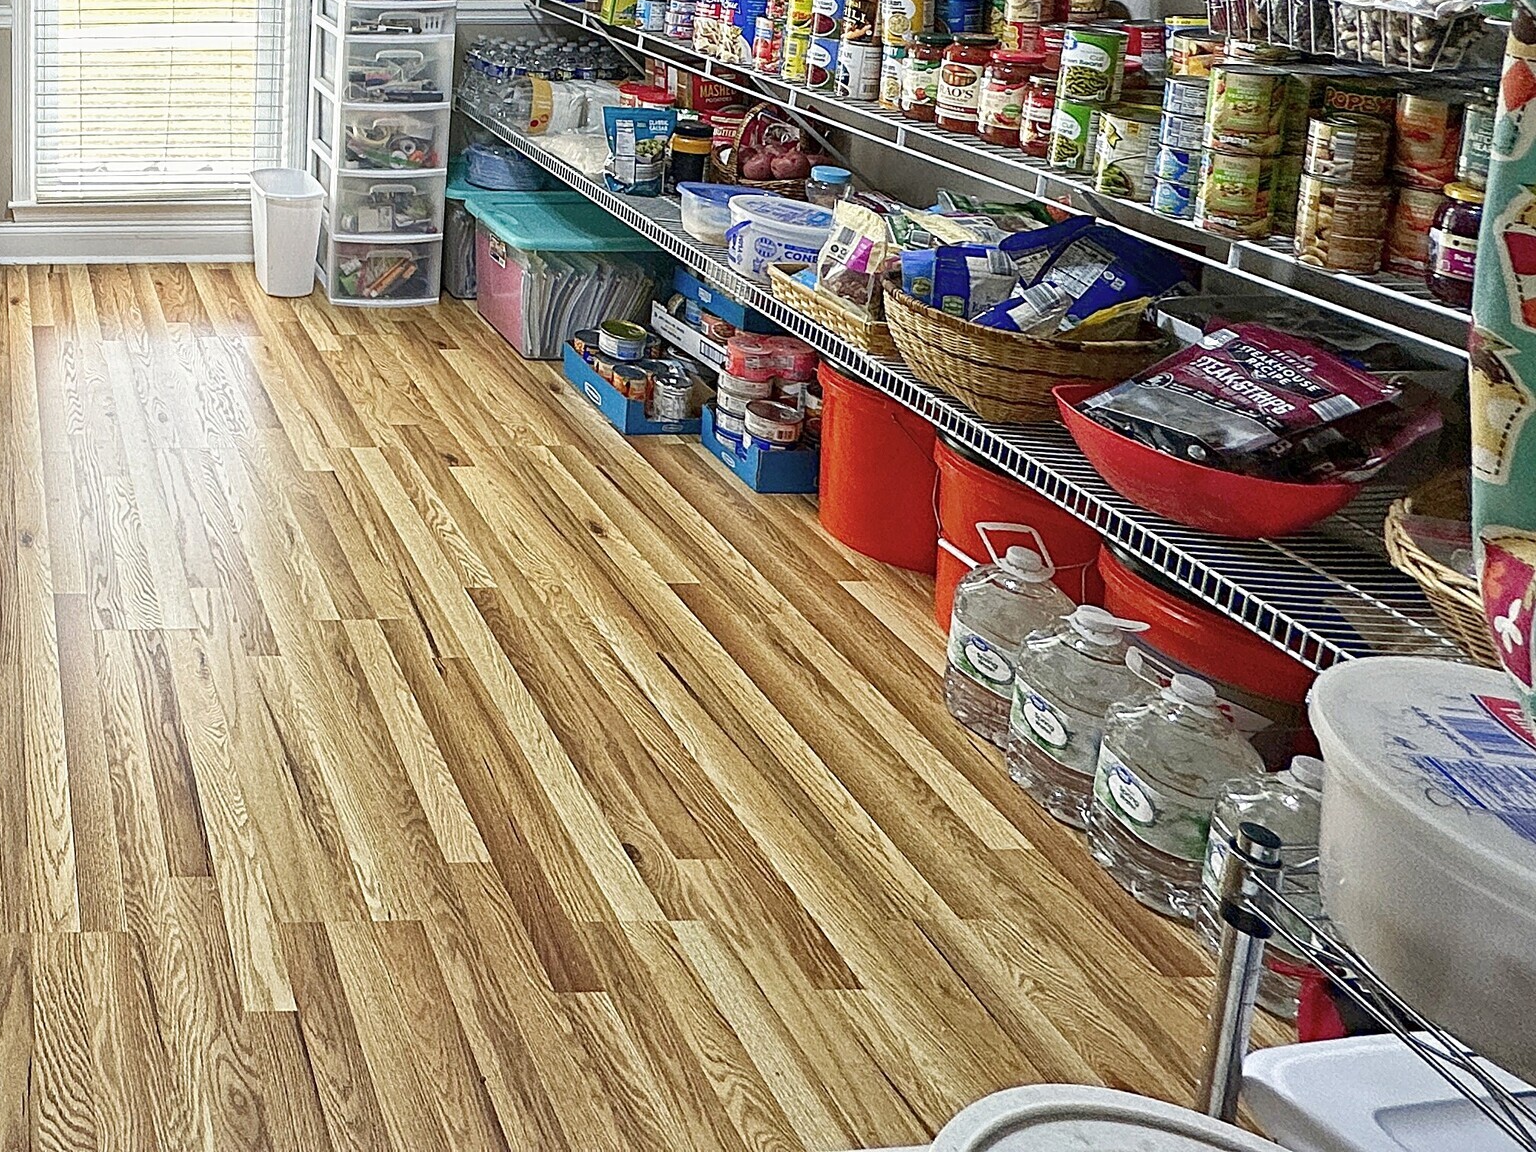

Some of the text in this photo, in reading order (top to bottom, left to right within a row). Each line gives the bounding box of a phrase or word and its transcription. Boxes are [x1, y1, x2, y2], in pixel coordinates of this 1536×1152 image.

[1079, 59, 1104, 69] Beans
[1089, 54, 1106, 62] Cut
[939, 84, 975, 99] RAO'S
[1325, 86, 1386, 112] POPEY
[1240, 345, 1322, 393] STEAKHOUSE
[1245, 356, 1292, 386] RECIPE
